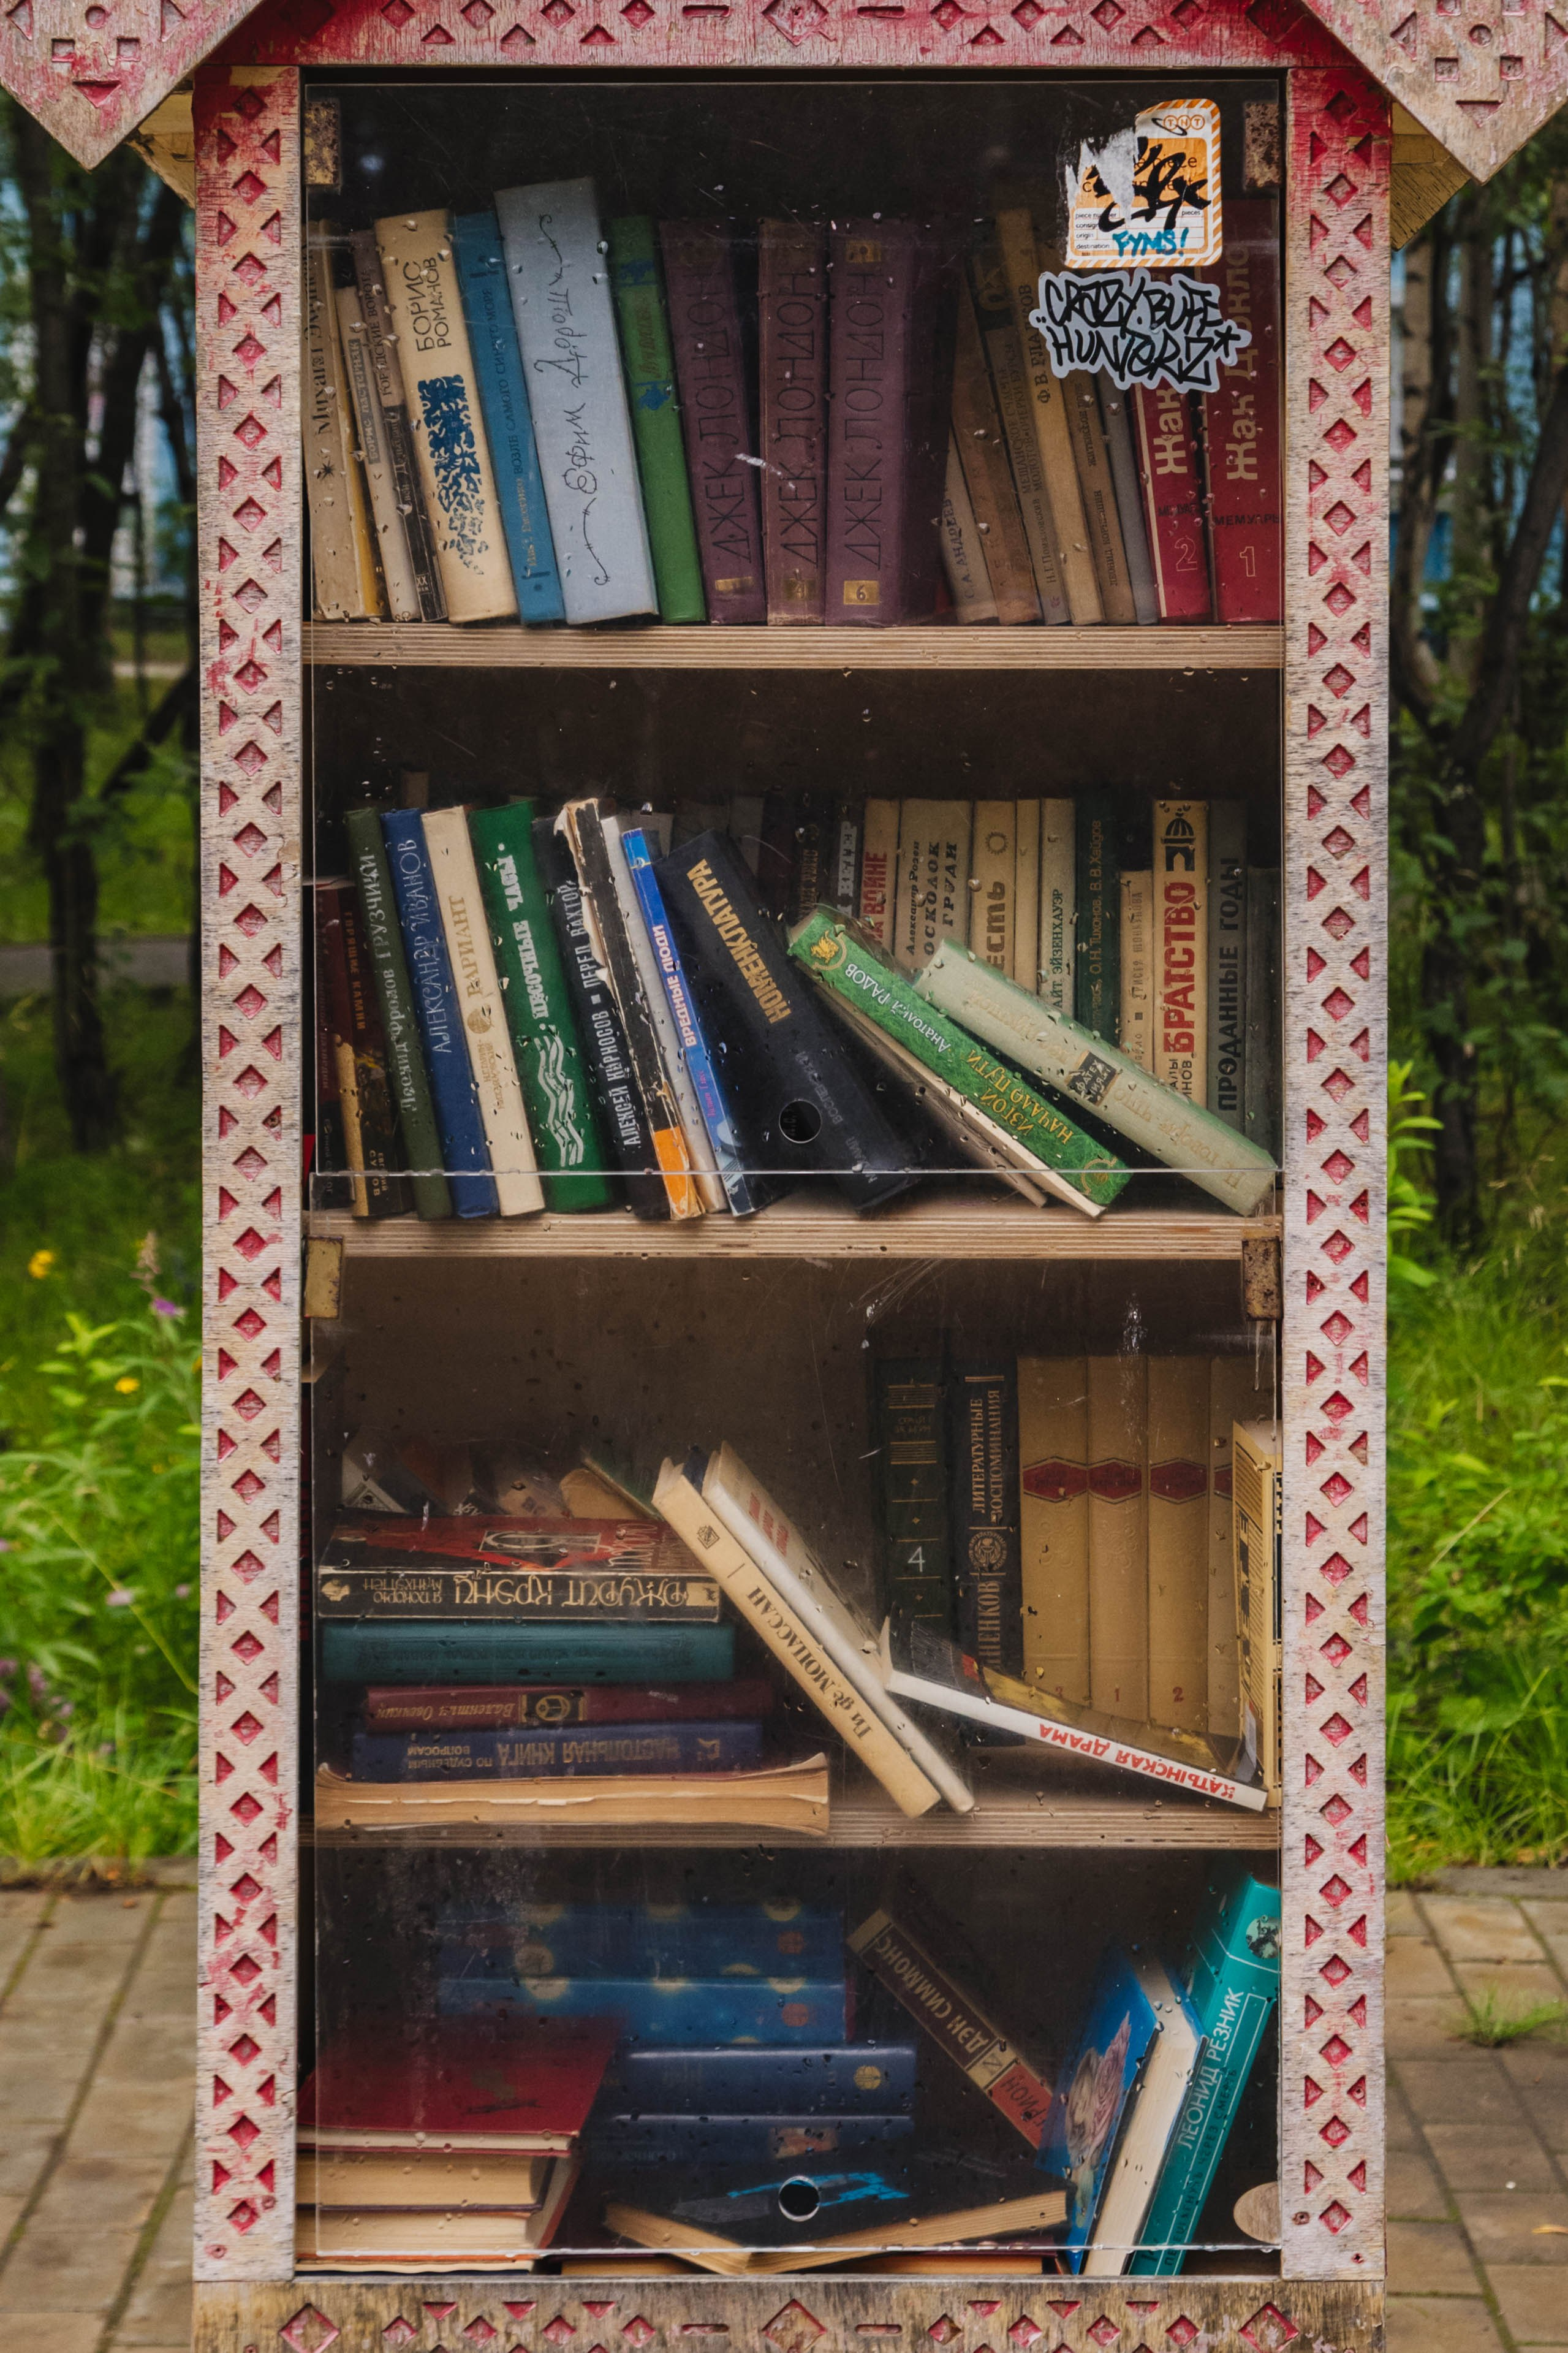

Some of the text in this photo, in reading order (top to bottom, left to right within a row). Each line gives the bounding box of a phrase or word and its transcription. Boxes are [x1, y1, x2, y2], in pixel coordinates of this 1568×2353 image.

[1165, 116, 1204, 129] TNT
[403, 260, 436, 352] БОРИС
[423, 257, 451, 348] РОМАНОВ
[481, 287, 496, 321] МОРЯ
[494, 378, 517, 430] САМОГО
[562, 401, 597, 494] Ефим
[681, 271, 751, 564] ДЖЕК ЛОНДОН
[776, 272, 818, 570] ДЖЕК ЛОНДОН
[844, 272, 884, 572] ДЖЕК ЛОНДОН
[1153, 387, 1188, 475] Жак
[1226, 395, 1258, 481] Жак
[506, 433, 523, 474] ВОЗЛЕ
[855, 584, 866, 601] 6
[1104, 549, 1118, 587] ЛЕОНИД
[1174, 538, 1198, 571] 2
[1240, 546, 1255, 577] 1
[360, 854, 392, 960] ГРУЗЧИКИ
[863, 851, 887, 915] ВОЙНЕ
[905, 840, 920, 956] Александр Розен
[923, 841, 939, 956] ОСКОЛОК
[942, 842, 957, 927] ГРУДИ
[344, 912, 366, 1030] ГОРЯЩИЕ КАМНИ
[397, 839, 452, 1054] АЛЕКСАНДР ИВАНОВ
[449, 895, 484, 998] ВАРИАНТ
[497, 854, 549, 1019] ПЕСОЧНЫЕ ЧАСЫ
[687, 858, 791, 1024] НОМЕНКЛАТУРА
[1051, 889, 1064, 1009] АЙТ ЭЙЗЕНХАУЭР
[1163, 882, 1195, 1054] БРАТСТВО
[382, 968, 405, 1041] Фролов
[651, 924, 697, 1047] ВРЕДНЫЕ ЛЮДИ
[844, 963, 890, 1005] РАДОВ
[1218, 858, 1241, 1112] ПРОДАННЫЕ ГОДЫ
[608, 1085, 642, 1146] АЛЕКСЕЙ
[964, 1049, 1074, 1144] НАЧАЛО ПУТИ
[977, 1087, 1034, 1137] ИЗГОЙ
[368, 1149, 382, 1196] СУОВ
[969, 1397, 985, 1515] ЛИТЕРАТУРНЫЕ
[452, 1575, 688, 1608] ДЖУДИТ КРЭНЦ
[907, 1546, 925, 1572] 4
[746, 1586, 836, 1695] МОПАССАН
[849, 1712, 873, 1741] Ги
[1172, 1686, 1184, 1703] 2
[406, 1745, 471, 1757] ВОПРОСАМ
[476, 1757, 493, 1768] ПО
[496, 1738, 680, 1766] НАСТОЛЬНАЯ КНИГА
[1039, 1724, 1236, 1800] КАТЫНСКАЯ ДРАМА
[873, 1936, 990, 2055] ДЭН СИММОНС
[1176, 1986, 1244, 2150] ЛЕОНИД РЕЗНИК
